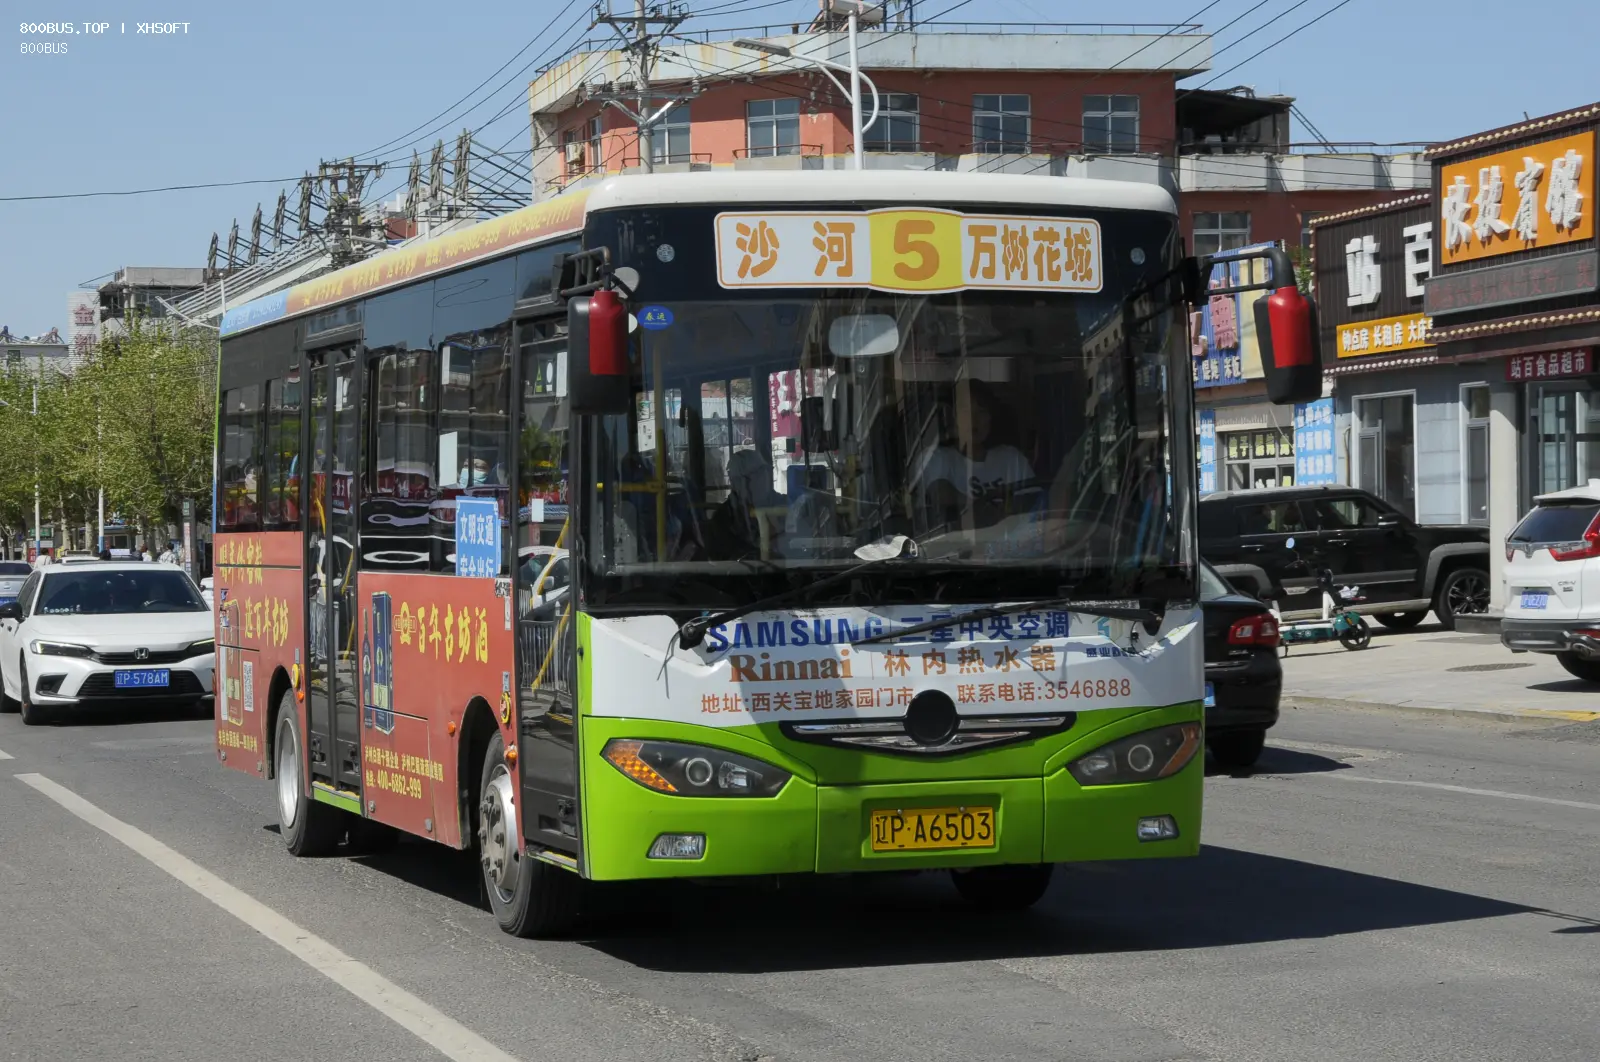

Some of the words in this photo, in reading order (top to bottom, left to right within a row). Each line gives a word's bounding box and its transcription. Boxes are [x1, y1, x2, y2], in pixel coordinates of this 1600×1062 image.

[1442, 148, 1584, 250] 快捷宾馆
[735, 219, 856, 279] 沙河
[893, 219, 940, 281] 5
[967, 223, 1093, 283] 万树花城
[1342, 328, 1370, 351] 钟点房
[1373, 322, 1403, 347] 长租房
[1510, 350, 1586, 379] 站百食品超市
[460, 512, 494, 546] 文明交通
[417, 602, 488, 664] 百年古坊酒
[708, 616, 883, 652] SAMSUNG
[729, 648, 853, 682] Rinnai
[884, 644, 1057, 678] 林内热水器
[701, 686, 914, 714] 地址:西关宝地家园门市
[956, 678, 1132, 704] 联系电话:3546888
